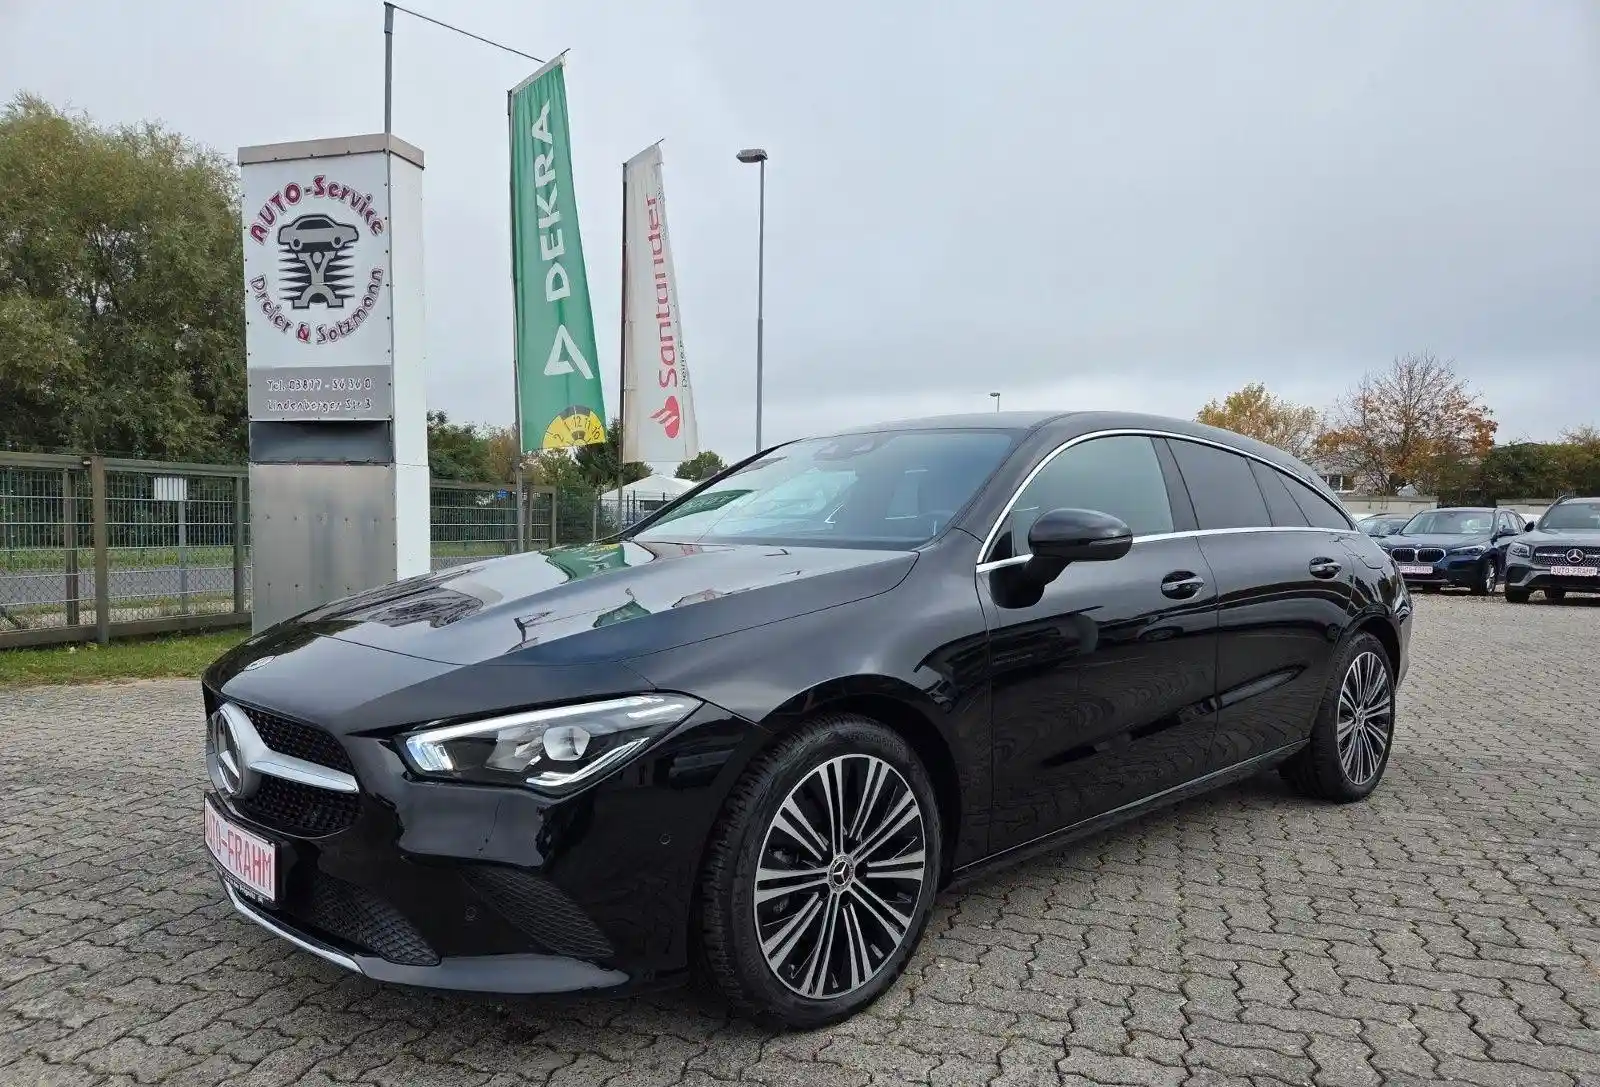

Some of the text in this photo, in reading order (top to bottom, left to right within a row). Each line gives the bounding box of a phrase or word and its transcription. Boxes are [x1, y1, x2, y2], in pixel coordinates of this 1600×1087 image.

[249, 174, 384, 246] AUTO-Service
[531, 99, 571, 302] DEKRA
[249, 268, 384, 345] Dreier & Sotzmann
[645, 193, 678, 388] Santander
[267, 400, 342, 413] Lindenberger
[288, 379, 322, 391] 03877
